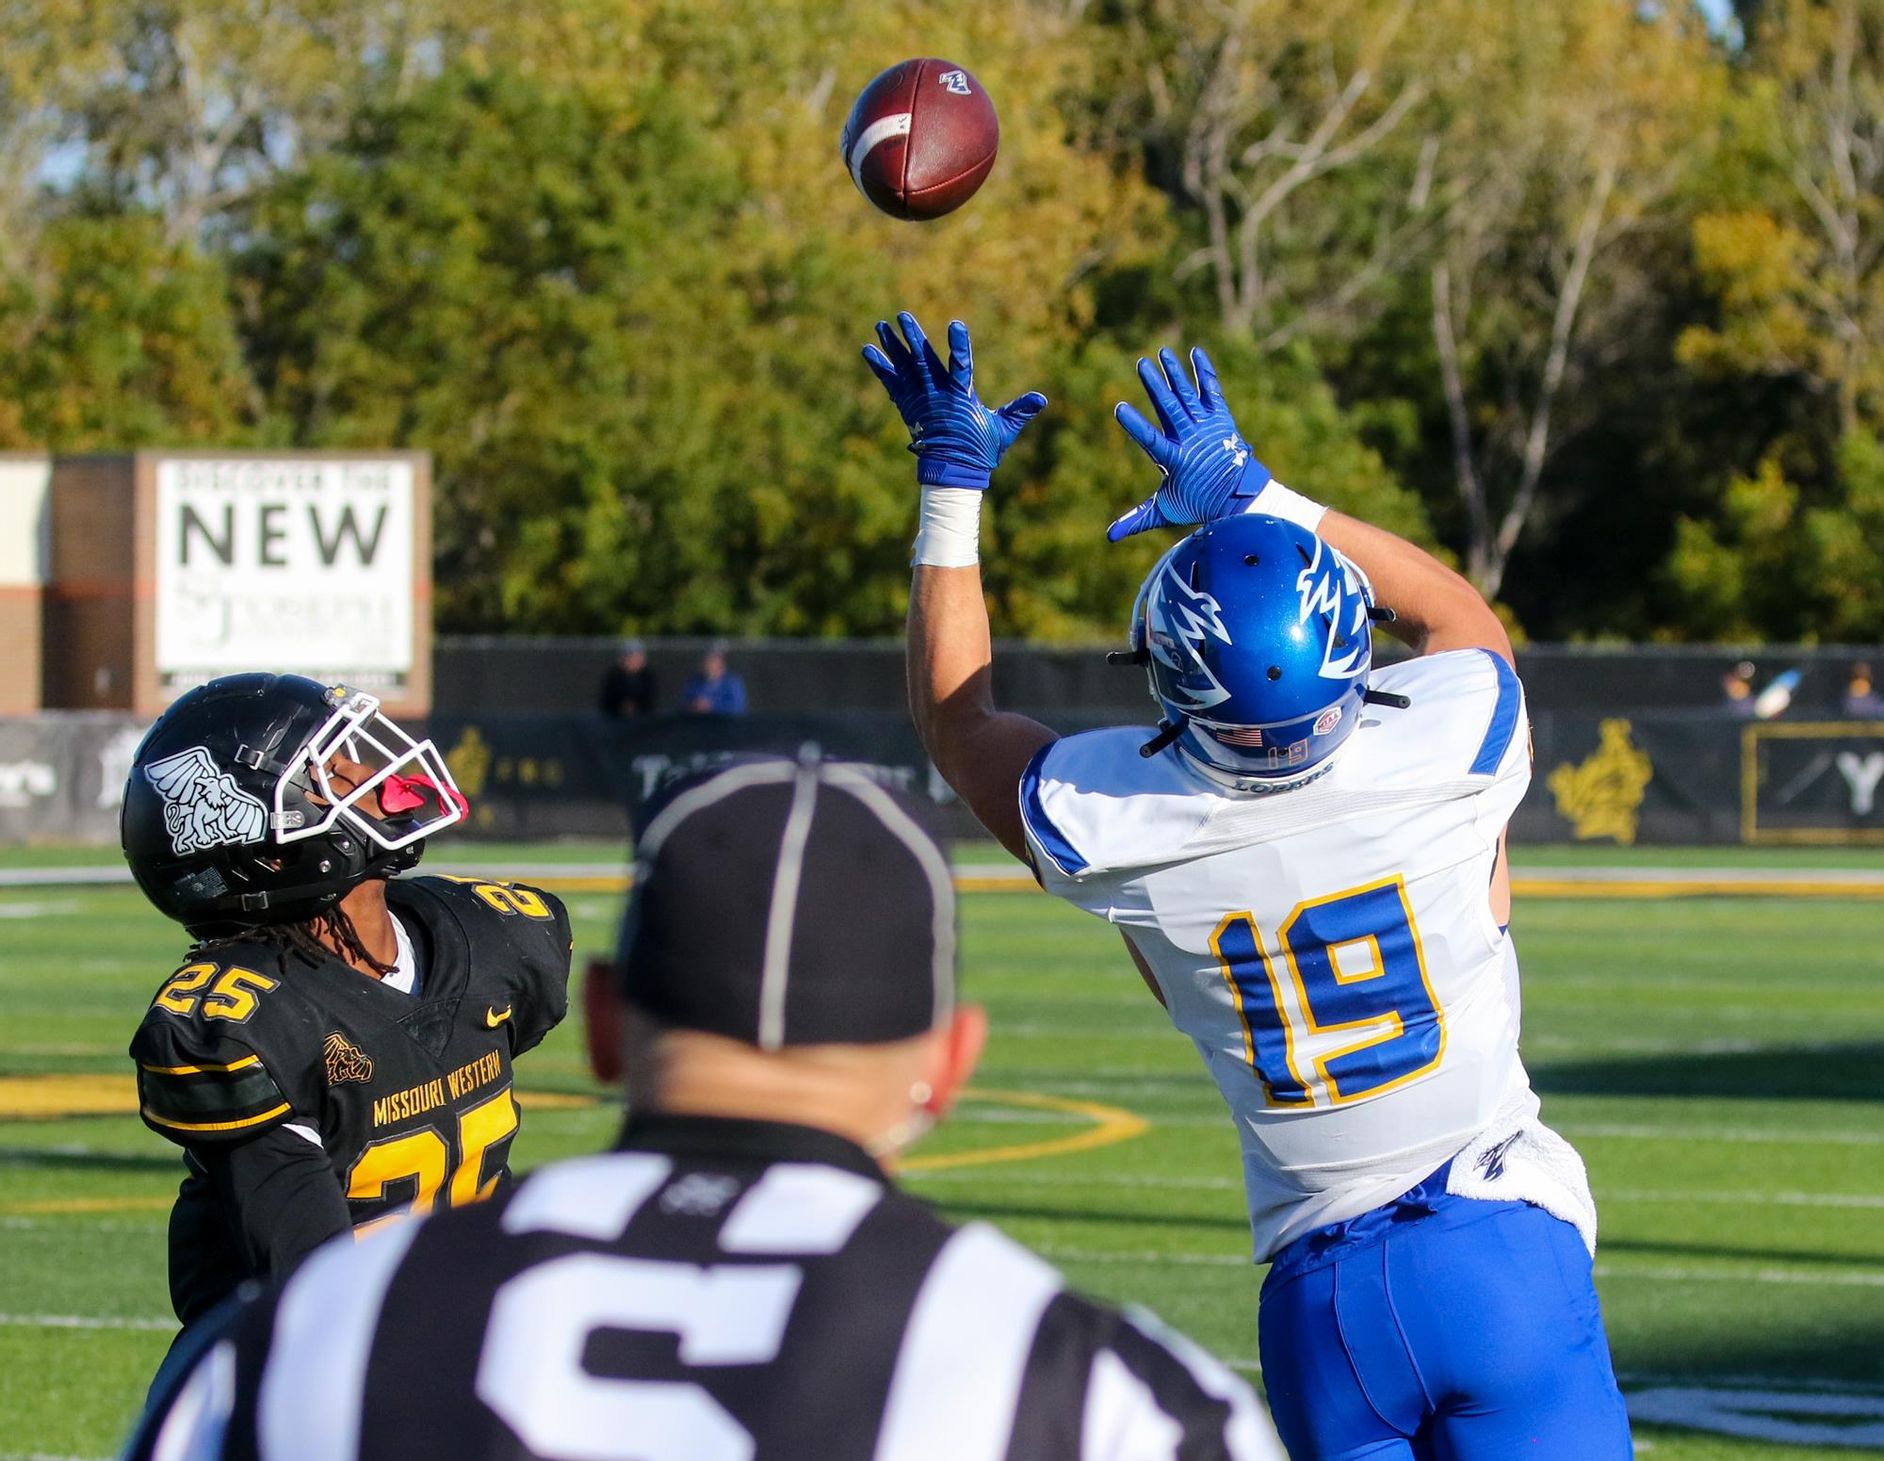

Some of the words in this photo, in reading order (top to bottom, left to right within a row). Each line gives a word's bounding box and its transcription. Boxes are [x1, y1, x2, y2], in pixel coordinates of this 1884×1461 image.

[178, 502, 388, 567] NEW
[1267, 738, 1309, 769] 19
[150, 961, 281, 1024] 25
[1207, 872, 1447, 1107] 19
[373, 1078, 447, 1128] MISSOURI
[447, 1049, 501, 1100] WESTERN
